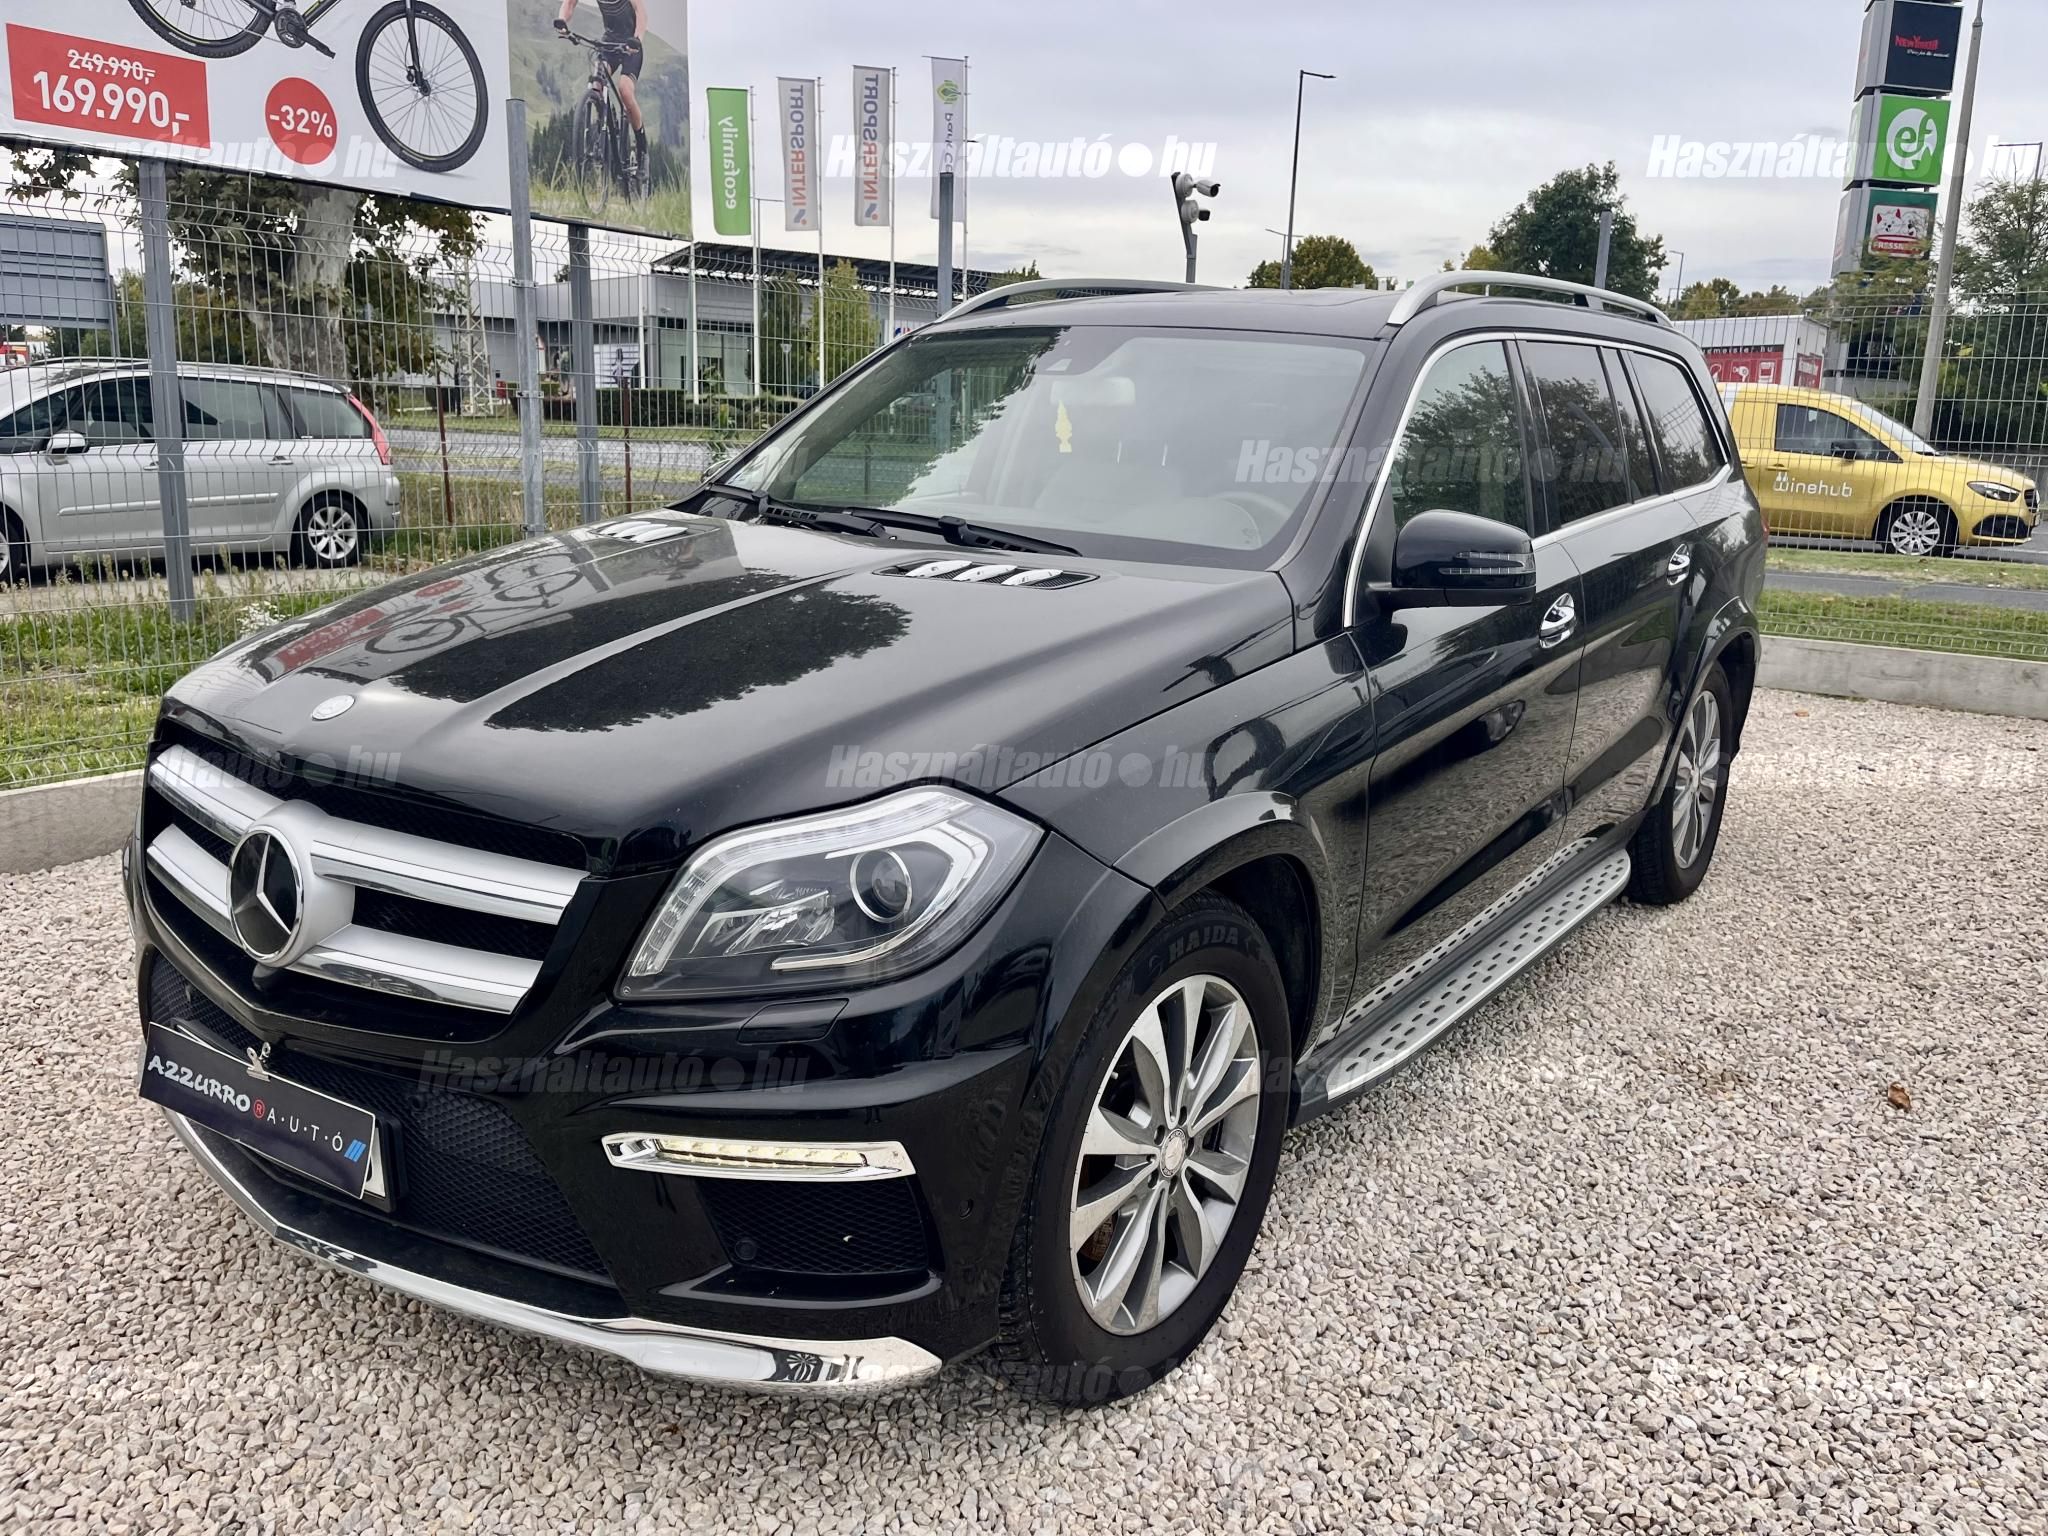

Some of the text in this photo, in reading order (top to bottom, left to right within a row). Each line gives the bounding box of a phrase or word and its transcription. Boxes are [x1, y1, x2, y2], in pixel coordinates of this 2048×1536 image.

[33, 70, 190, 137] 169.990,-
[269, 104, 334, 139] -32%
[1168, 925, 1239, 963] HAIDA
